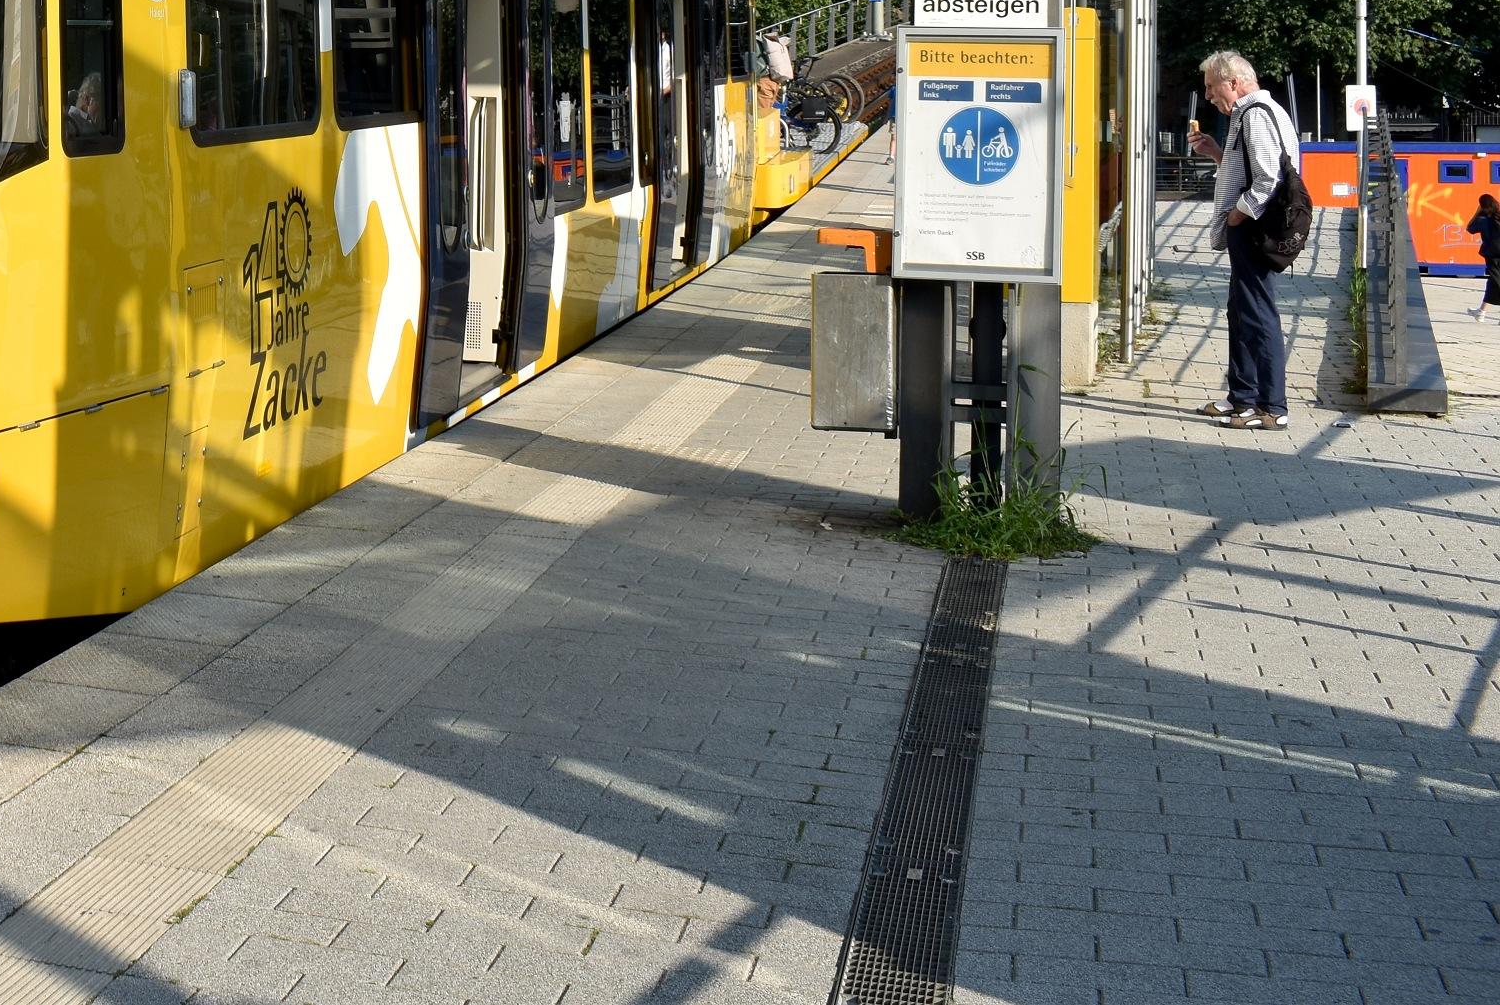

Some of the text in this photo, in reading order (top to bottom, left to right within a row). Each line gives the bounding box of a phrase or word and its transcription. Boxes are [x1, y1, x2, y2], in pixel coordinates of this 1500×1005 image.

[920, 49, 1034, 65] Bitte beachten:
[923, 82, 959, 91] Fußgänger
[990, 83, 1024, 92] Radfahrer
[923, 91, 940, 99] links
[966, 251, 986, 260] SSB
[266, 294, 310, 351] Jahre
[243, 327, 328, 441] Zacke
